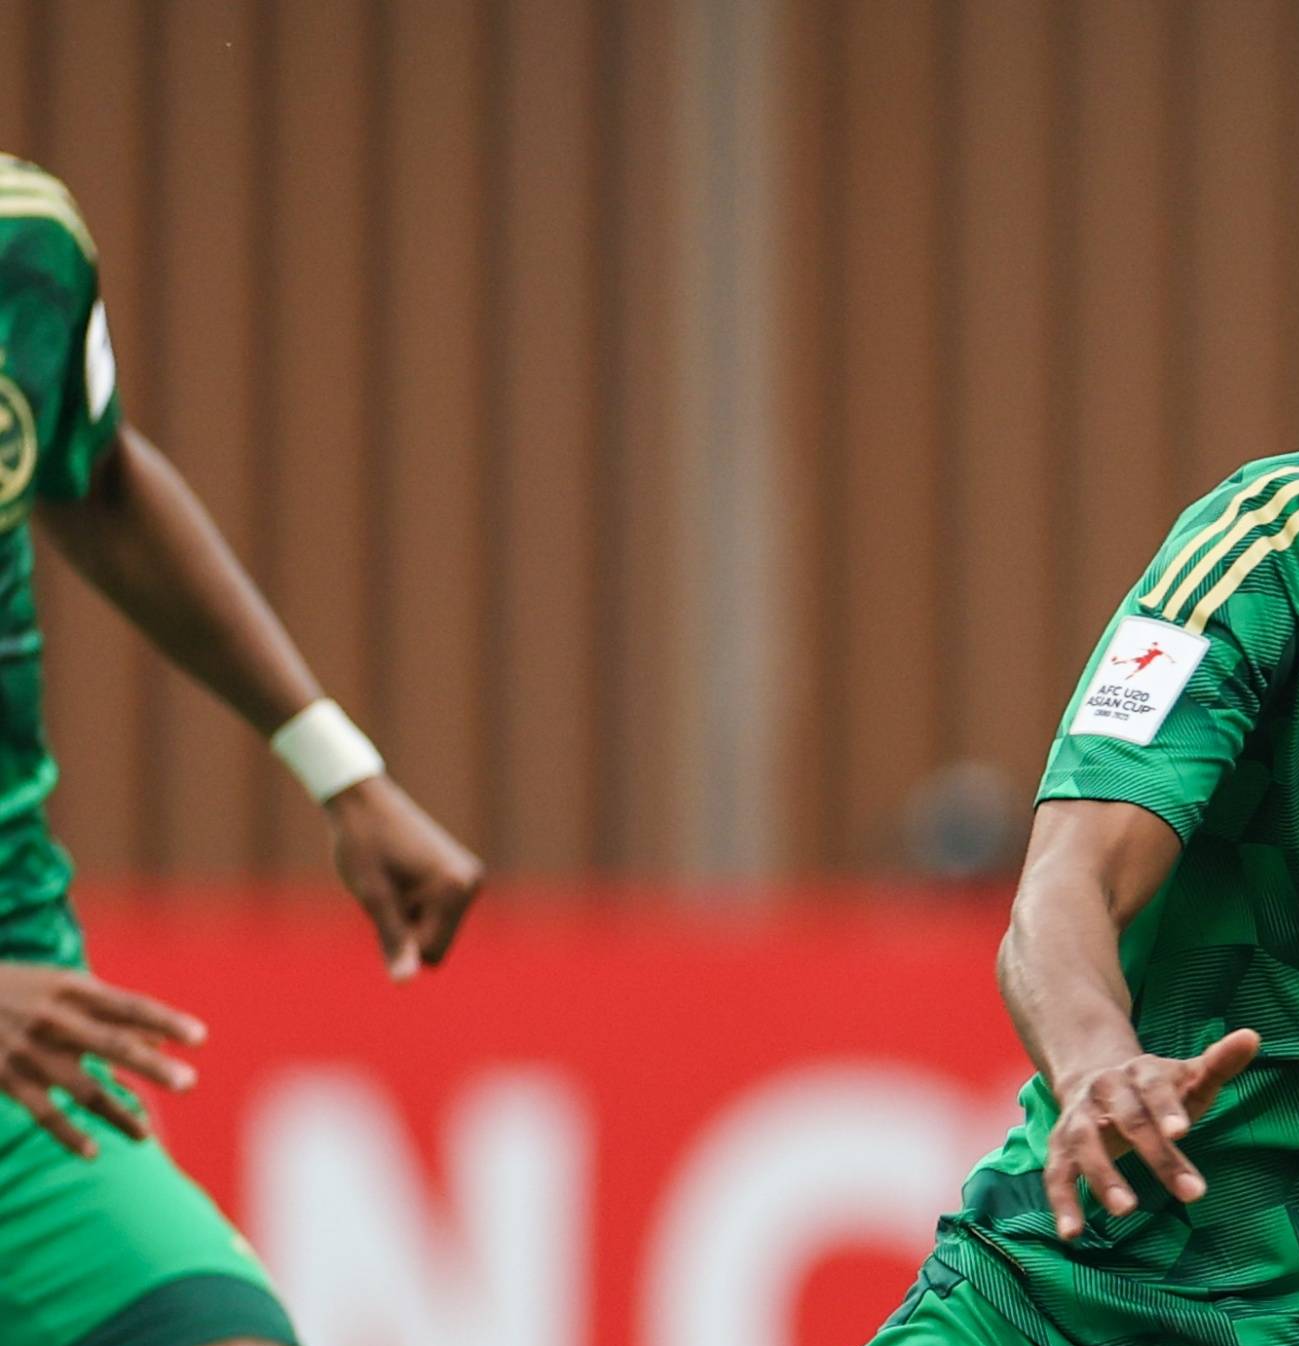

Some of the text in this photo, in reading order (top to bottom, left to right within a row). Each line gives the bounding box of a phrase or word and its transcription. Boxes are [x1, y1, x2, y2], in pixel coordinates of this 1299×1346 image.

[1097, 685, 1150, 703] AFC U20
[1086, 696, 1153, 714] ASIAN CUP
